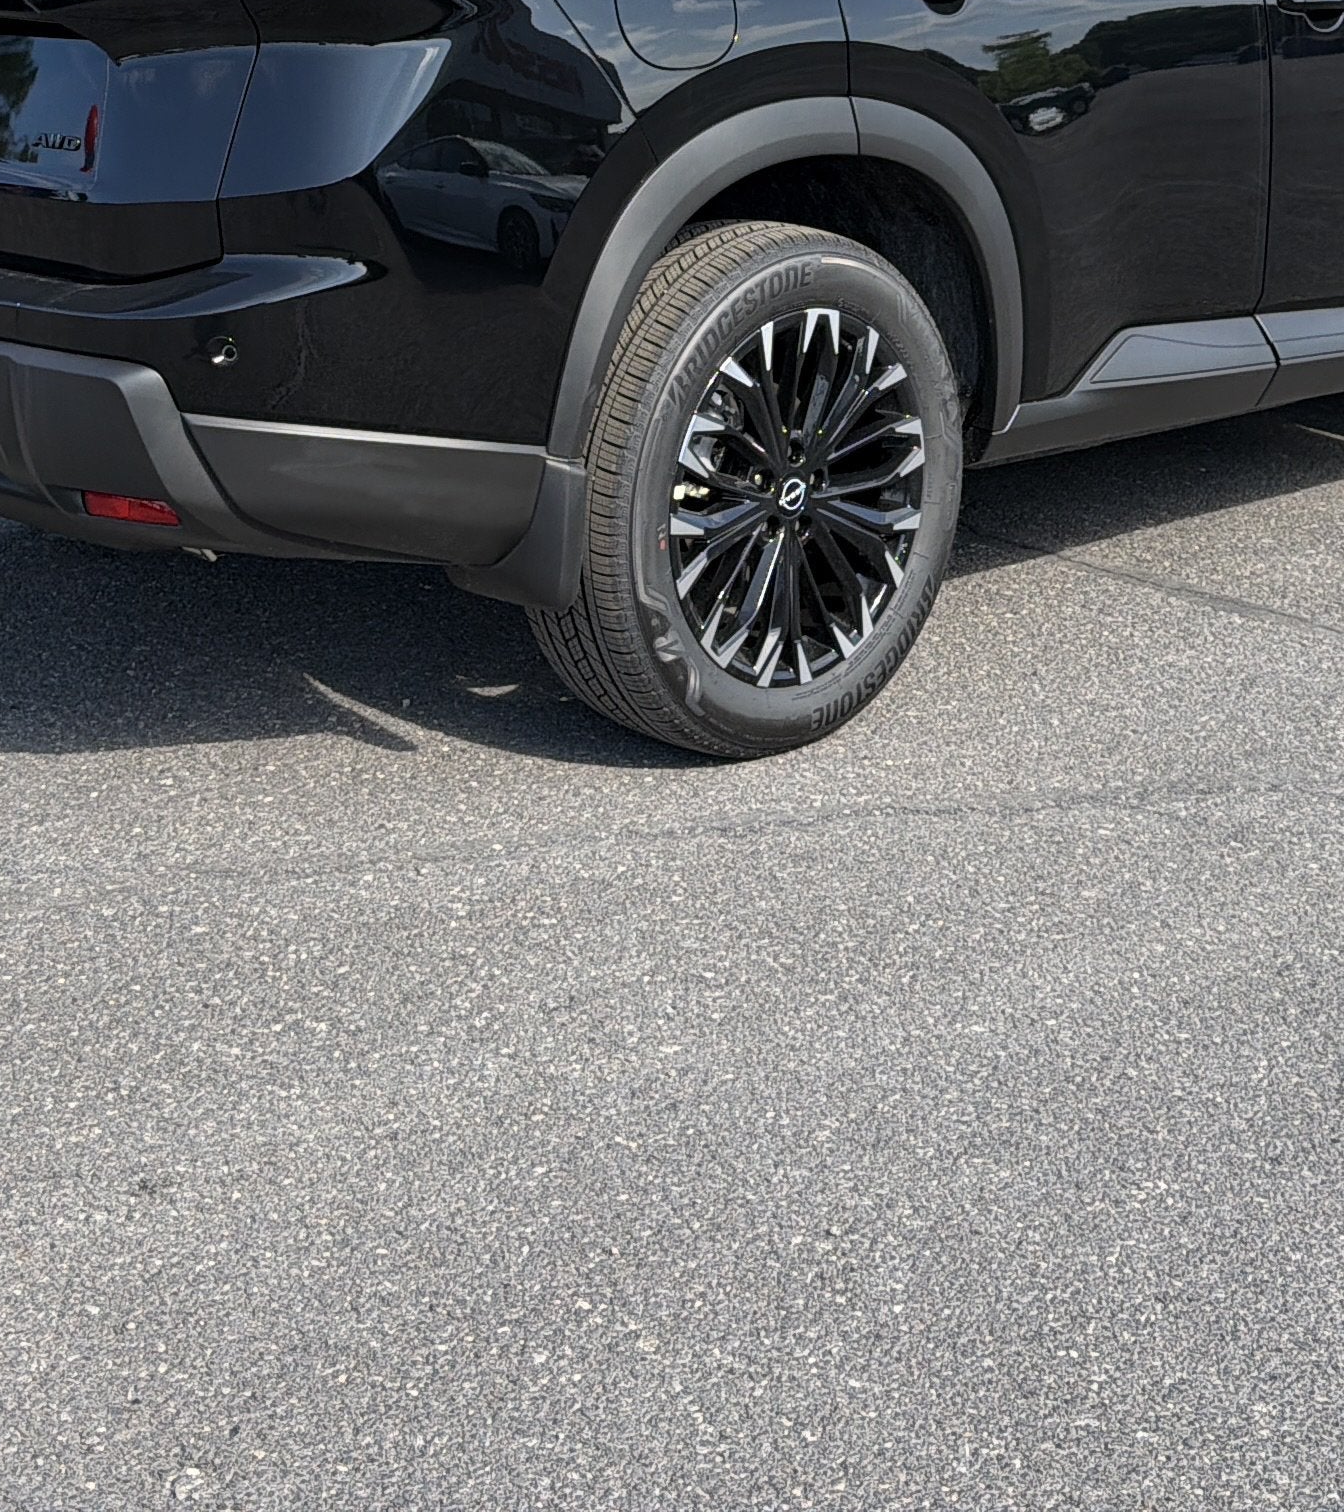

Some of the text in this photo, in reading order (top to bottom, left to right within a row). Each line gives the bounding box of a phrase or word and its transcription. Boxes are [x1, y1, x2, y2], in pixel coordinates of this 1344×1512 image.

[31, 133, 82, 151] AWD
[667, 260, 815, 408] BRIDGESTONE
[810, 574, 936, 733] BRIDGESTONE
